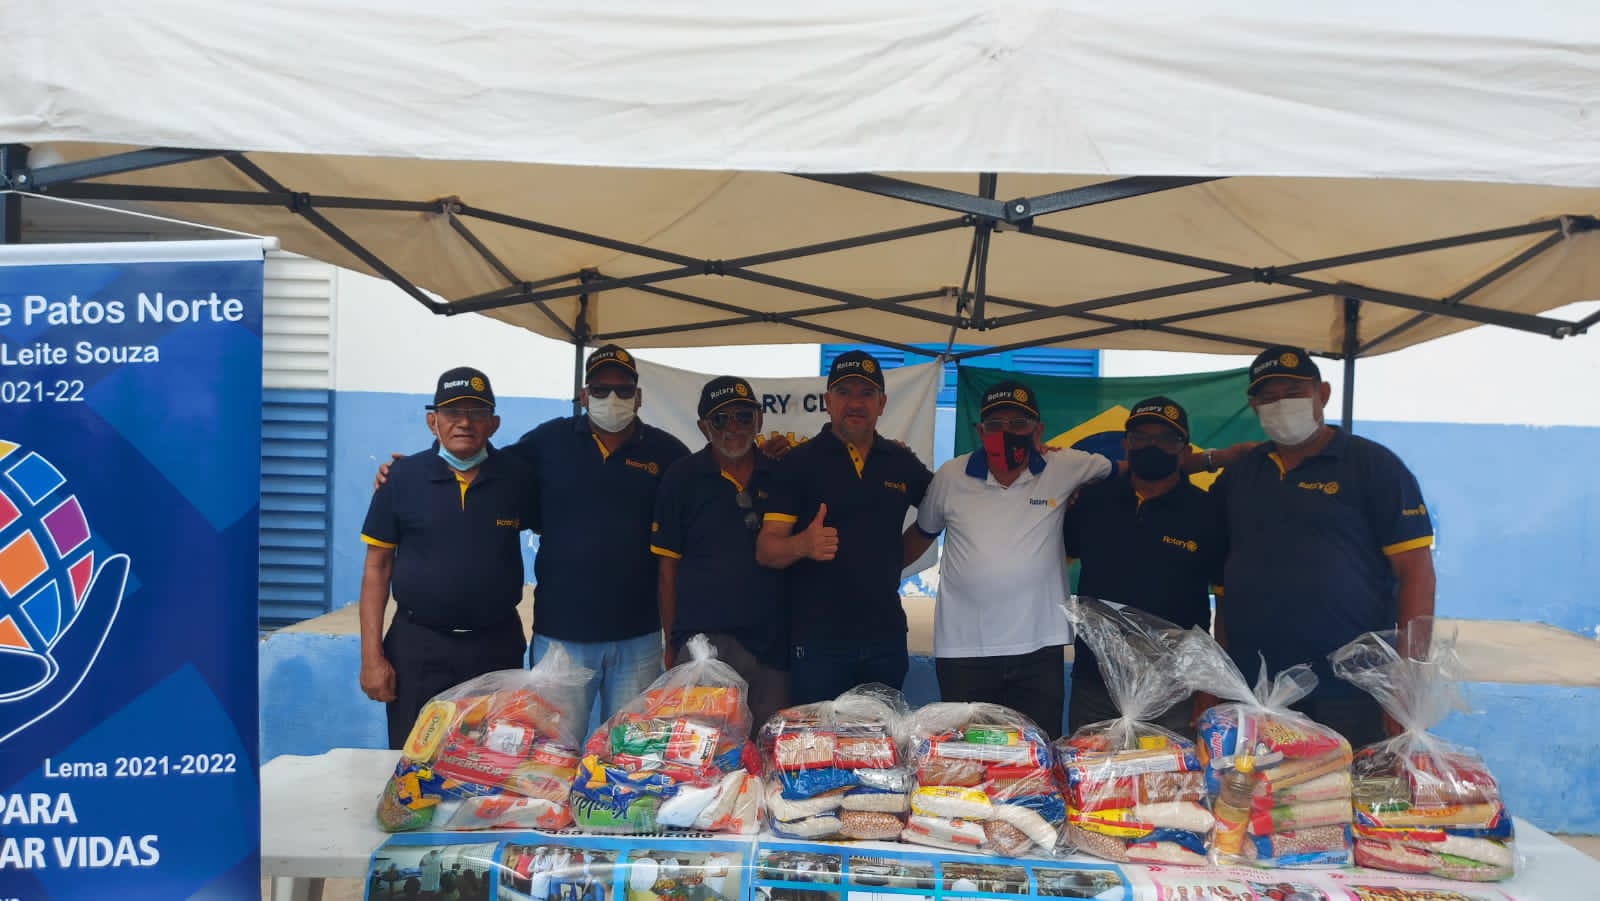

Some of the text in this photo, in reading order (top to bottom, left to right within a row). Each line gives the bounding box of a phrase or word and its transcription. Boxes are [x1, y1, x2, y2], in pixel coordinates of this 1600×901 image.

[24, 295, 126, 326] Patos
[138, 292, 244, 323] Norte
[1, 341, 160, 366] Leite Souza
[443, 380, 470, 390] Rotary
[711, 386, 734, 400] Rotary
[1029, 497, 1048, 507] Rotary
[1163, 535, 1186, 549] Rotary
[45, 753, 237, 778] Lema 2021-2022
[52, 835, 161, 868] VIDAS
